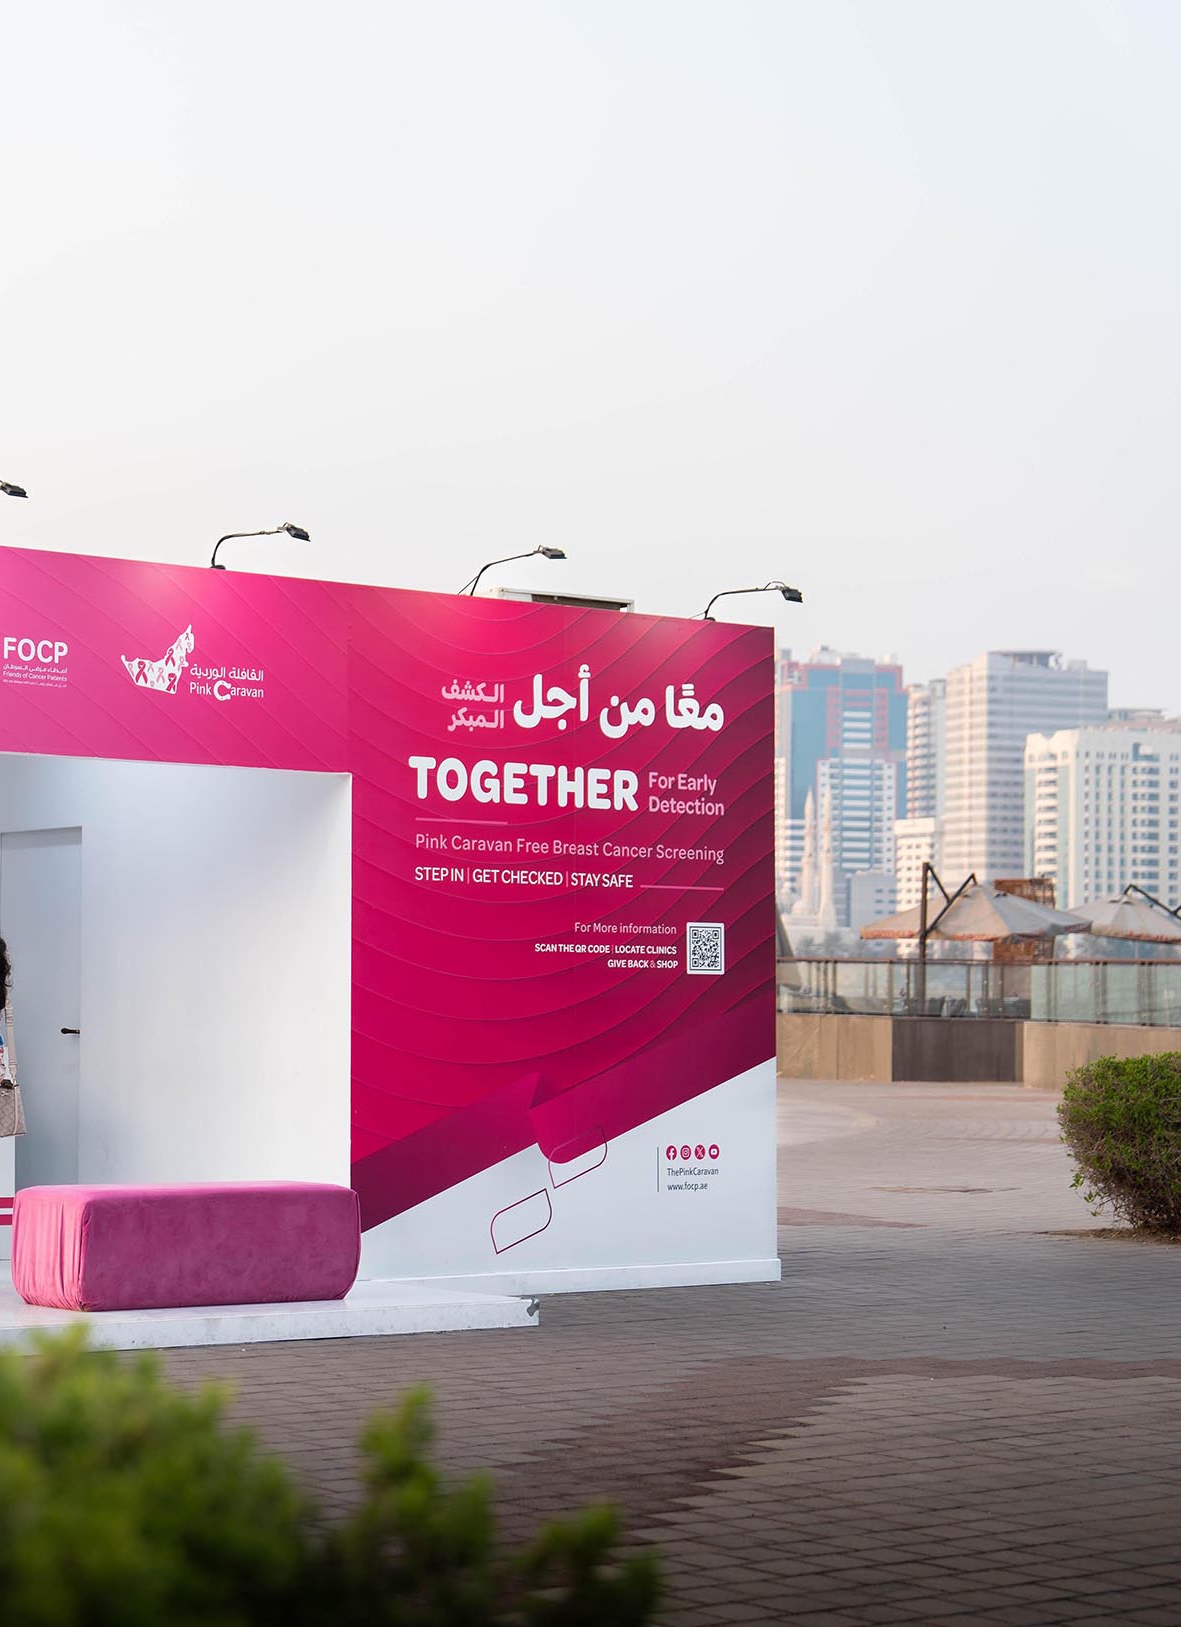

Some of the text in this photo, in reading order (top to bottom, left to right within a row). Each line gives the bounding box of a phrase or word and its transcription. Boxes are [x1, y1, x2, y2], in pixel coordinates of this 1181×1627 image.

[3, 636, 68, 664] FOCP
[29, 673, 47, 681] Cancer
[189, 663, 264, 682] القافلة الوردية
[189, 679, 264, 701] Pink Caravan
[441, 678, 505, 704] الكشف
[513, 663, 592, 731] أجل
[447, 706, 505, 732] المبكر
[599, 695, 656, 739] من
[408, 755, 639, 812] TOGETHER
[648, 771, 717, 796] For Early
[648, 796, 725, 816] Detection
[415, 833, 725, 865] Pink Caravan Free Breast Cancer Screening
[414, 866, 634, 888] STEP IN GET CHECKED STAY SAFE
[574, 921, 677, 935] For More information
[534, 943, 677, 955] SCAN THE QR CODE LOCATE CLINICS
[607, 959, 627, 968] GIVE
[627, 959, 649, 969] BACK
[656, 960, 679, 969] SHOP
[666, 1166, 719, 1177] ThePinkCaravan
[667, 1181, 708, 1192] www.focp.ae
